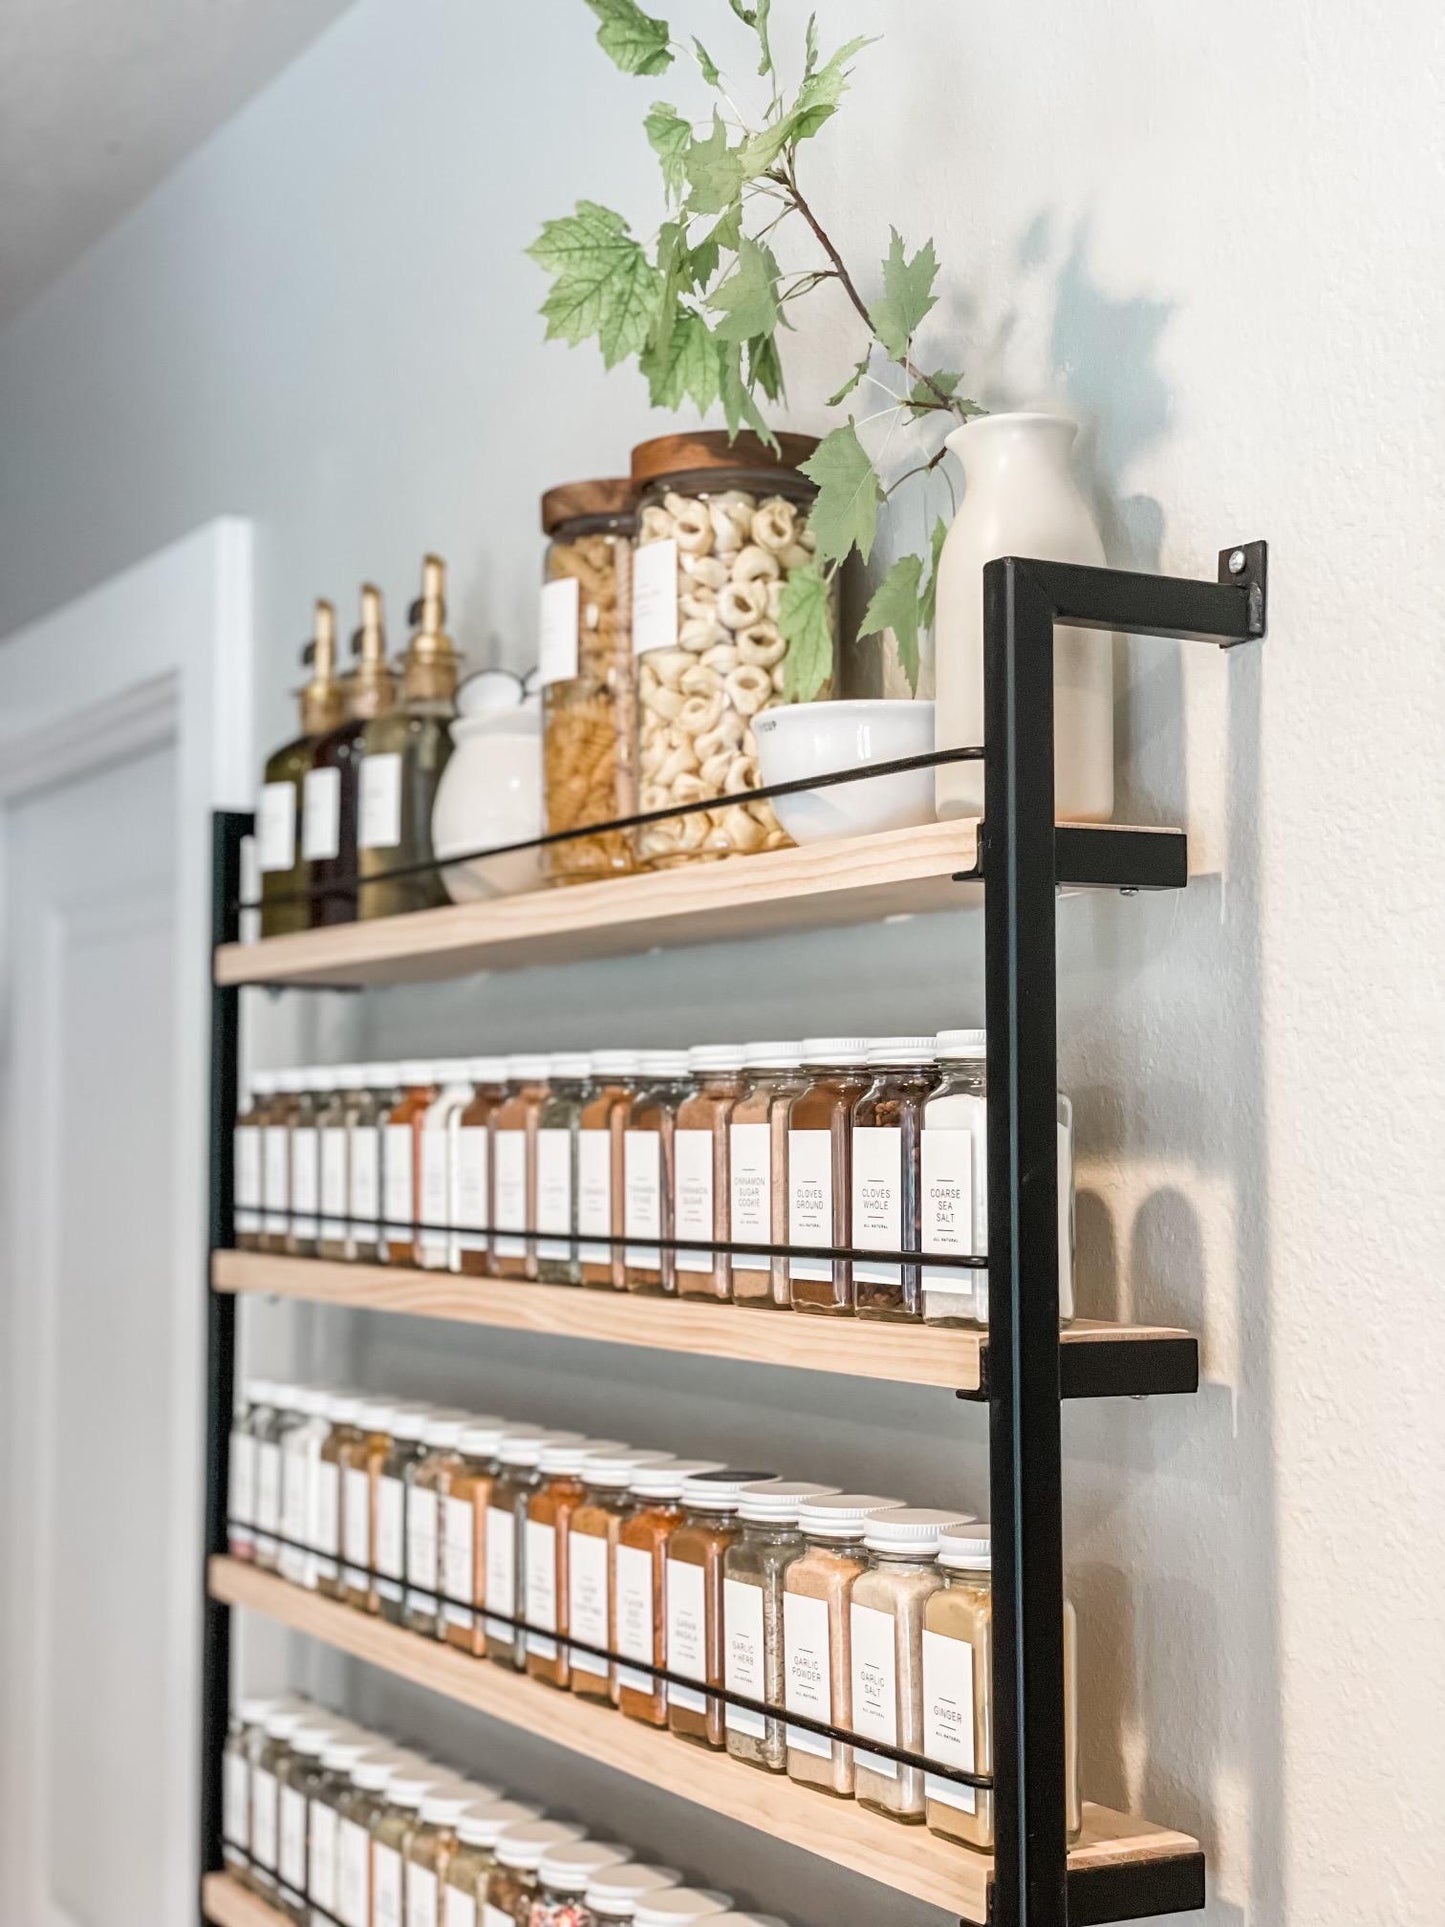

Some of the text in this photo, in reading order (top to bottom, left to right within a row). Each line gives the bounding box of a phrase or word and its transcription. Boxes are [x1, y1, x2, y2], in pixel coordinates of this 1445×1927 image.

[739, 1187, 760, 1197] SUGAR
[796, 1189, 823, 1199] CLOVES
[861, 1188, 891, 1199] CLOVES
[930, 1188, 961, 1199] COARSE
[738, 1198, 761, 1208] COOKIE
[796, 1199, 824, 1210] GROUND
[863, 1200, 889, 1210] WHOLE
[937, 1200, 953, 1211] SEA
[936, 1212, 955, 1223] SALT
[732, 1640, 754, 1655] GARLIC
[738, 1654, 754, 1666] HERB
[793, 1655, 819, 1671] GARLIC
[791, 1666, 822, 1682] POWDER
[860, 1671, 885, 1688] GARLIC
[864, 1683, 881, 1698] SALT
[933, 1705, 962, 1725] GINGER
[943, 1734, 962, 1744] NATURAL
